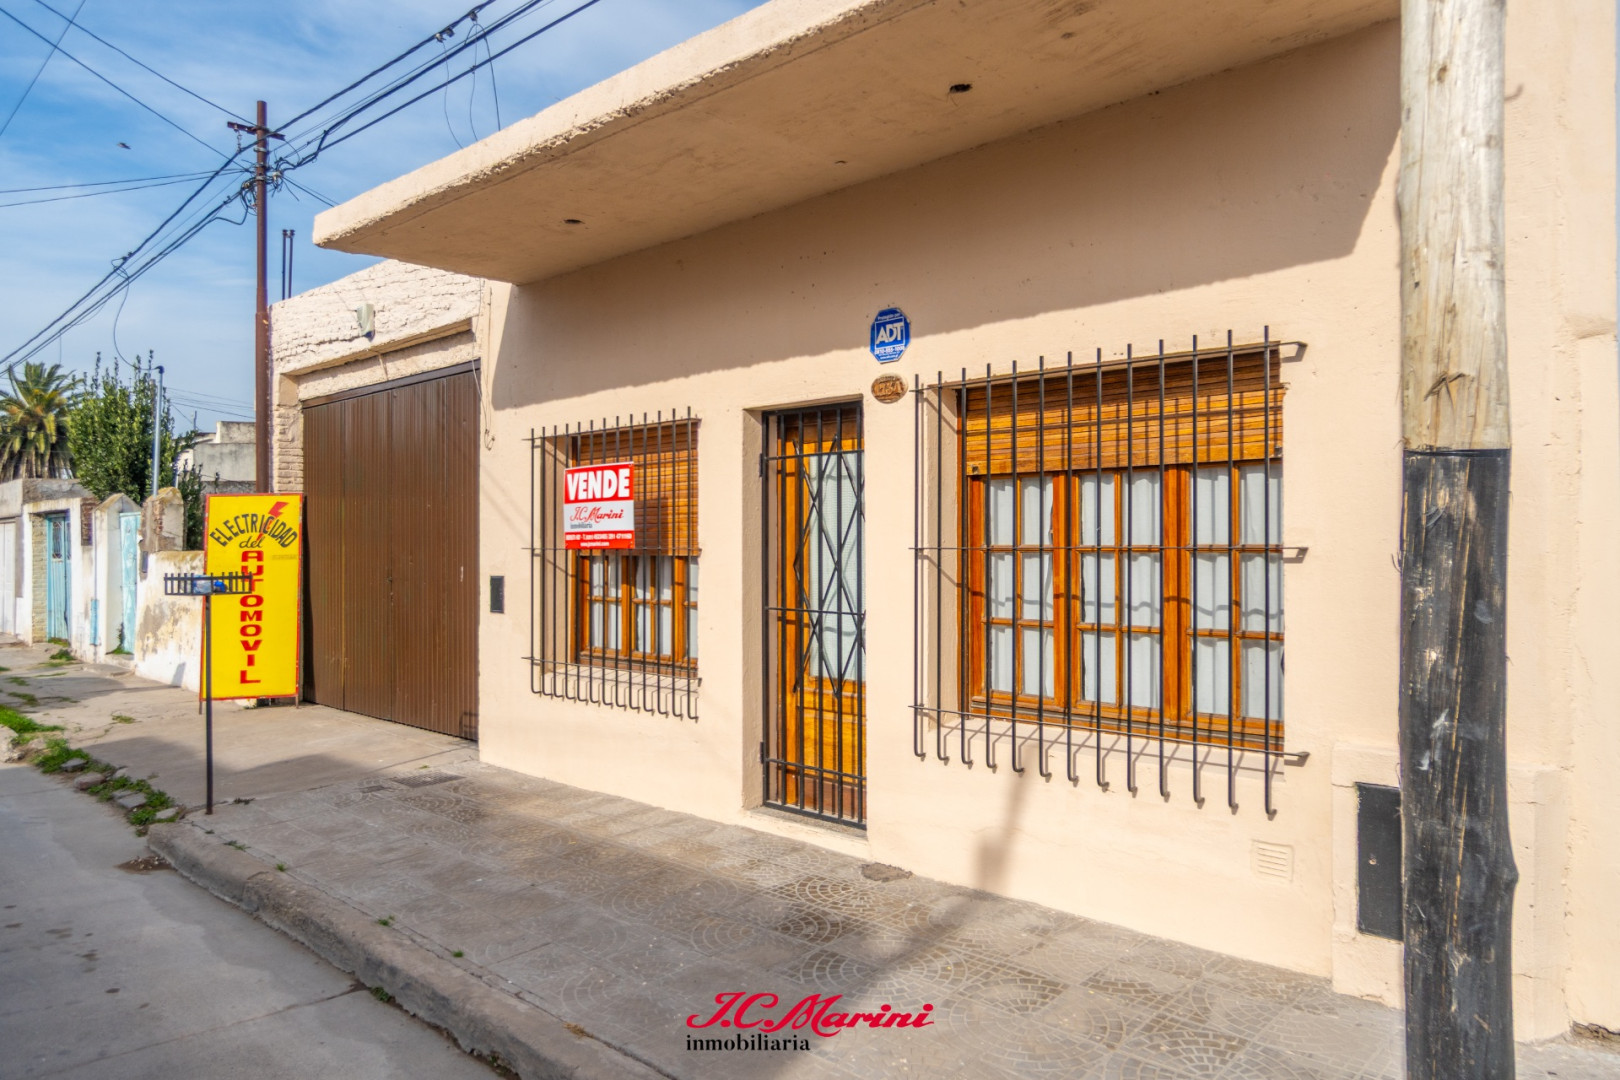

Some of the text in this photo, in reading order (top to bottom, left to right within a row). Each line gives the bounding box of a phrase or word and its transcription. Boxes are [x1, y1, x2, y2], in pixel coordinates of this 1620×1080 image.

[876, 322, 904, 345] ADT
[566, 468, 630, 501] VENDE
[209, 513, 298, 548] ELECTRICIDAD
[238, 535, 266, 549] del
[240, 550, 264, 684] AUTOMOVIL
